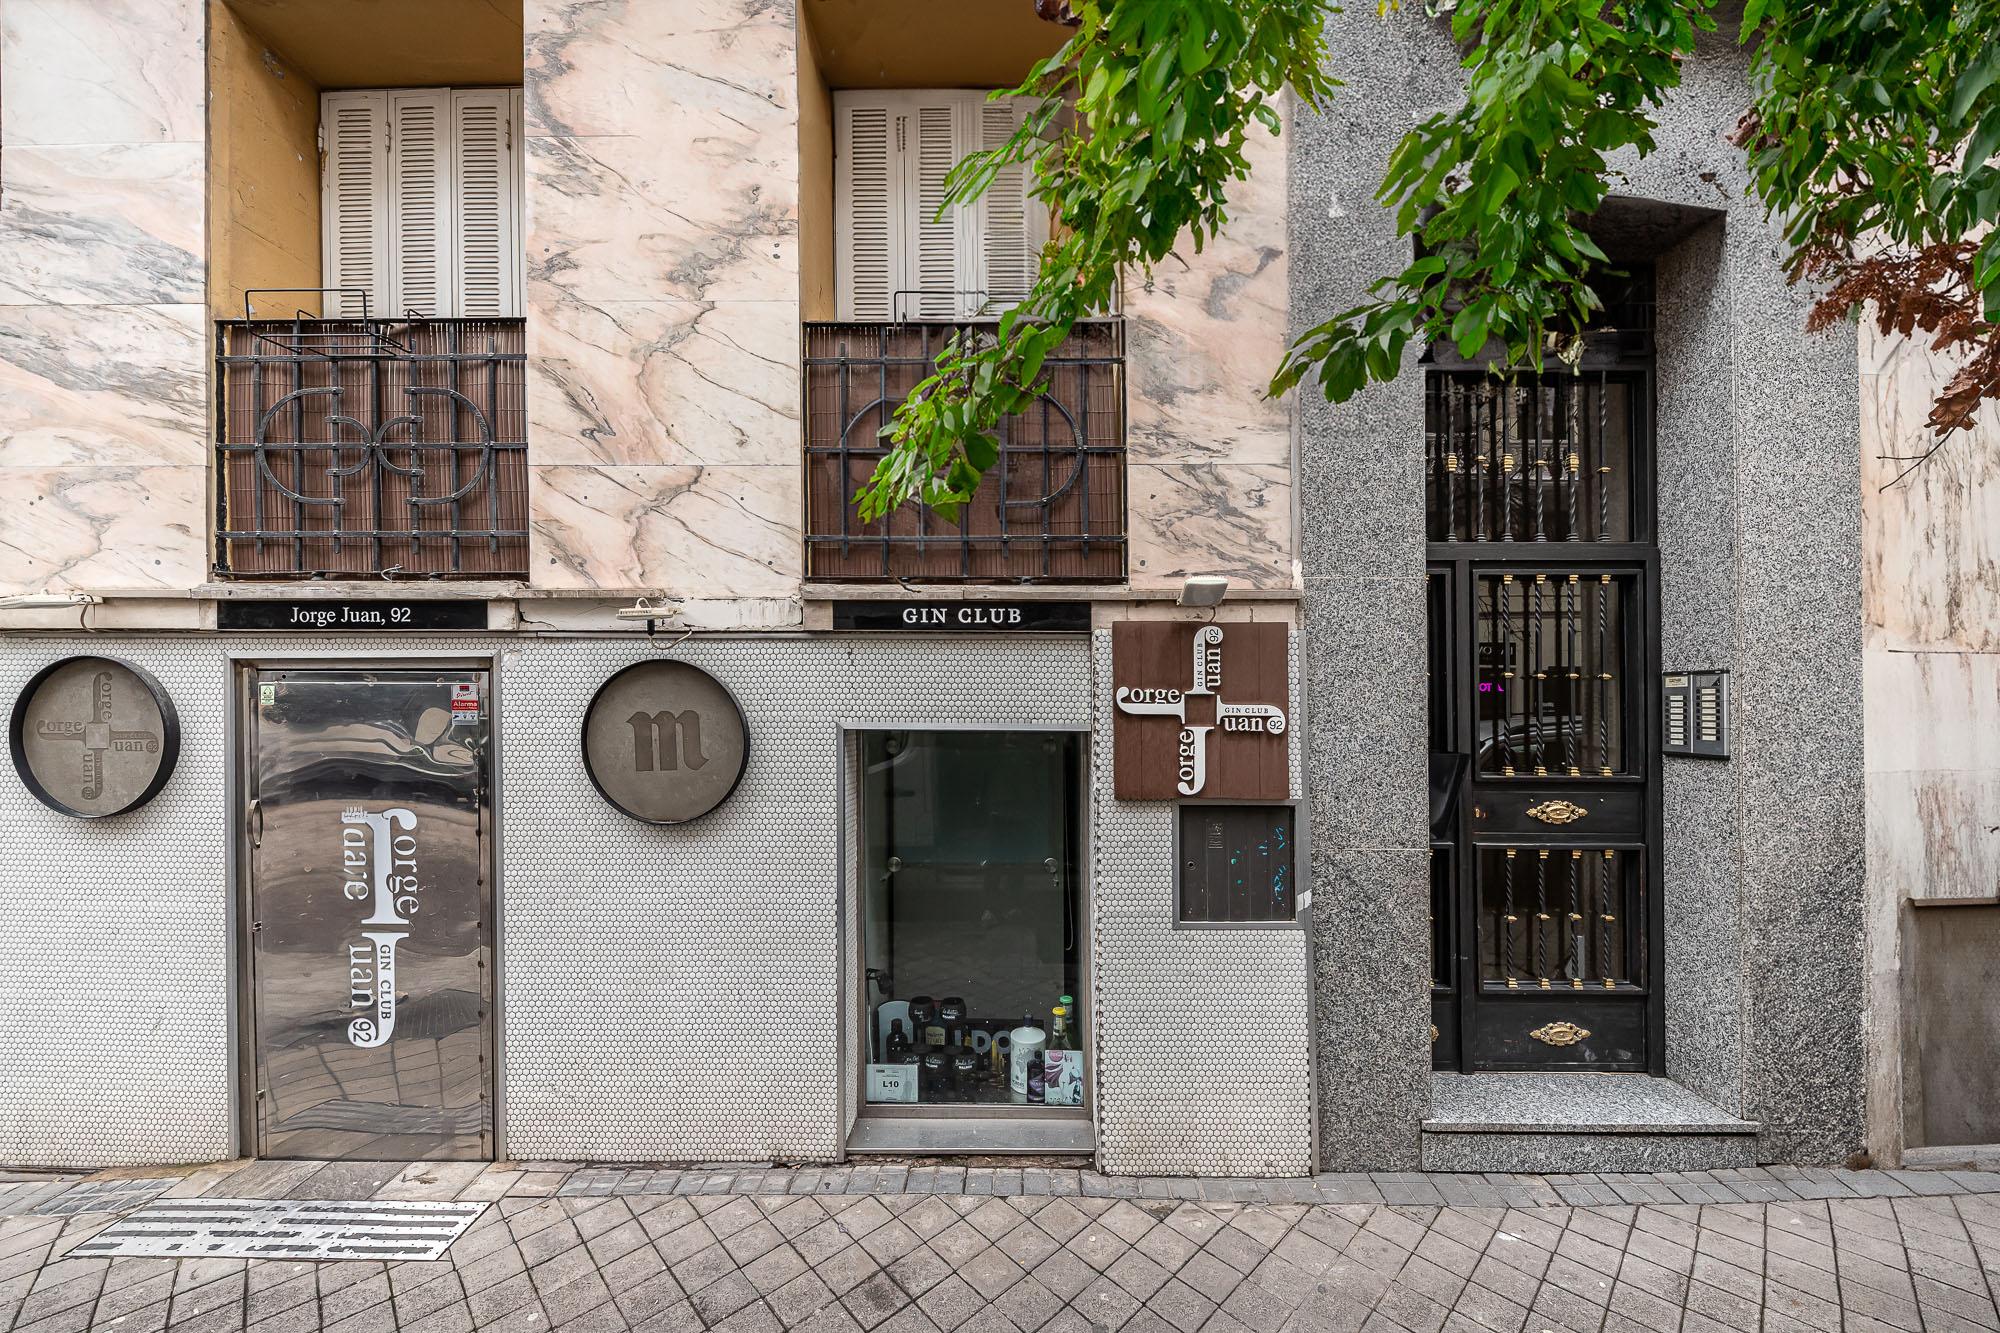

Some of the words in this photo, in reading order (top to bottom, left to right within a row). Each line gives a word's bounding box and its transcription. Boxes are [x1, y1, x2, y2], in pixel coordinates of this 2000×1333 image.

[290, 607, 336, 627] Jorge
[341, 607, 386, 625] Juan,
[390, 607, 412, 623] 92
[902, 608, 948, 624] GIN
[957, 608, 1022, 624] CLUB
[1224, 706, 1242, 714] GIN
[1244, 706, 1270, 714] CLUB
[1269, 719, 1283, 730] 92
[379, 944, 391, 971] GIN
[379, 980, 392, 1020] CLUB
[352, 1021, 372, 1043] 92
